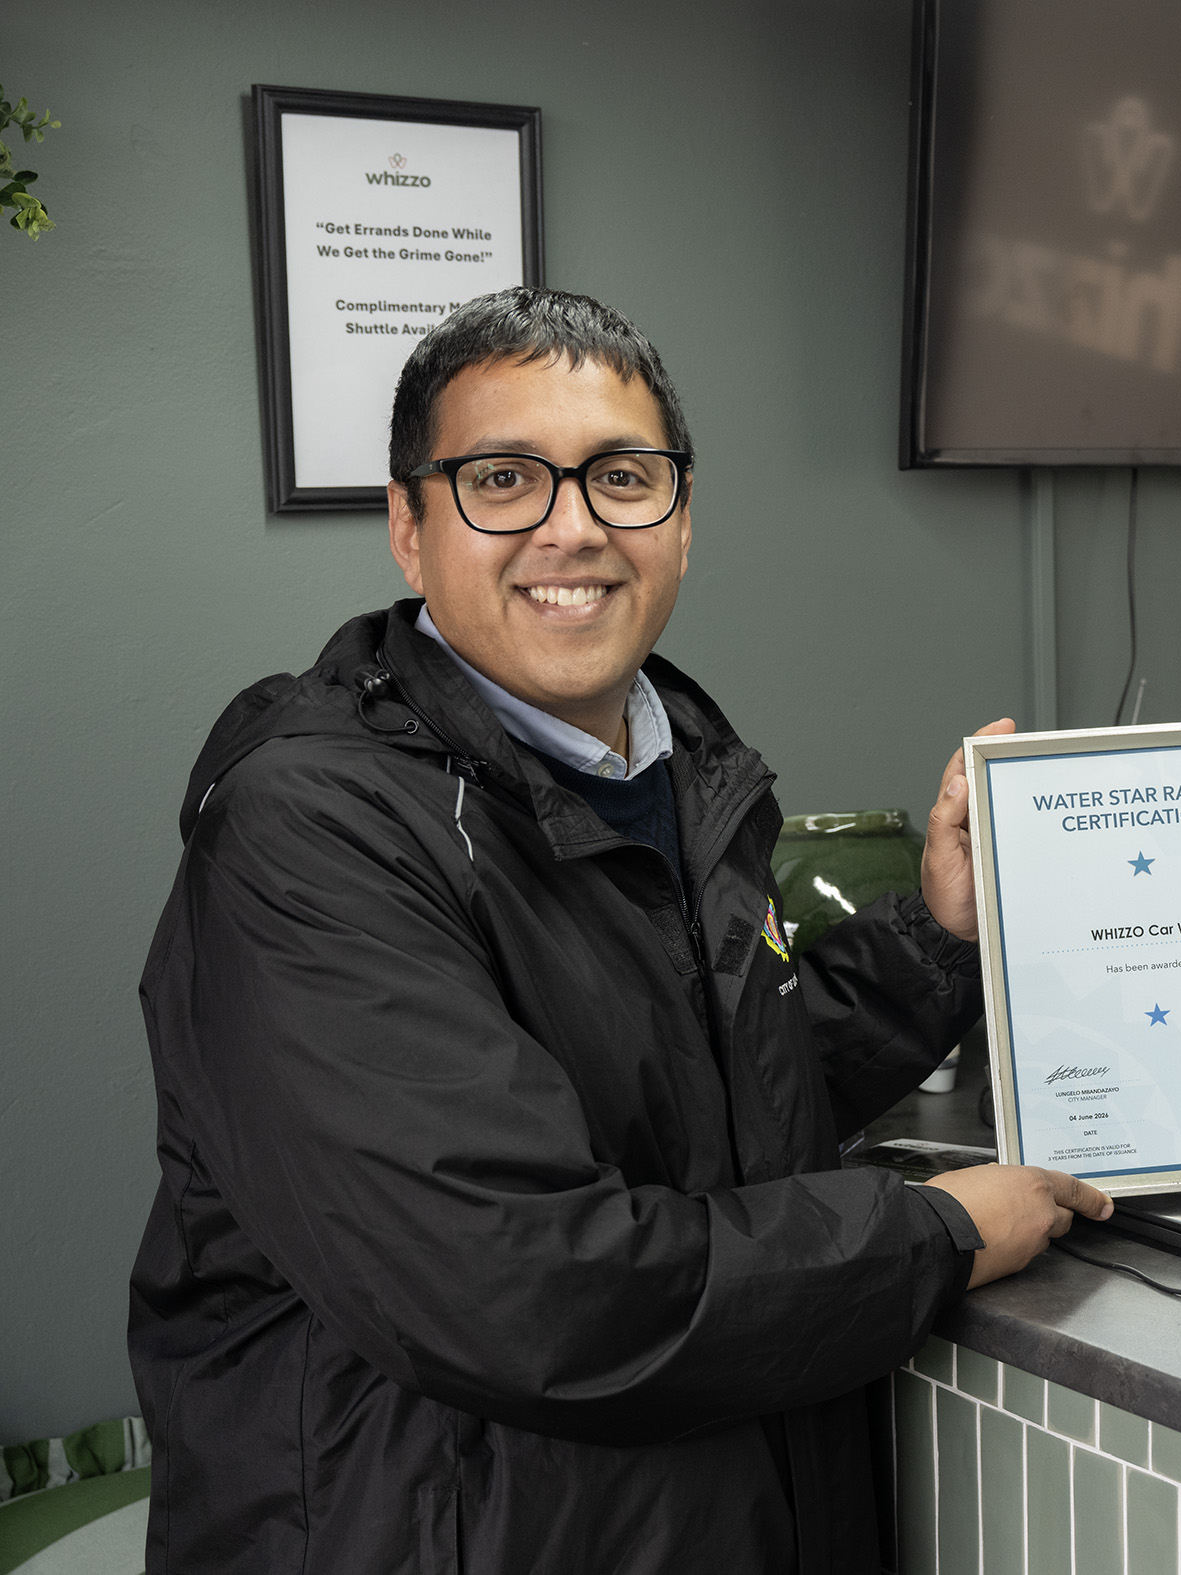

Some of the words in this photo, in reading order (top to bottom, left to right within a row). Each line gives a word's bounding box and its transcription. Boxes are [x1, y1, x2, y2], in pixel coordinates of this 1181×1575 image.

[365, 171, 432, 188] whizzo
[316, 222, 350, 235] “Get
[354, 224, 409, 237] Errands
[413, 227, 449, 239] Done
[452, 228, 492, 241] While
[317, 245, 340, 258] We
[344, 247, 368, 259] Get
[372, 248, 396, 260] the
[399, 249, 441, 262] Grime
[445, 251, 493, 263] Gone!”
[335, 300, 446, 316] Complimentary
[346, 323, 398, 335] Shuttle
[1032, 791, 1104, 811] WATER
[1109, 786, 1158, 806] STAR
[1091, 925, 1144, 941] WHIZZO
[1148, 924, 1173, 937] Car
[1106, 965, 1123, 974] Has
[1125, 963, 1148, 972] been
[1055, 1090, 1080, 1098] LUNGELO
[1065, 1145, 1100, 1154] CERTIFICATION
